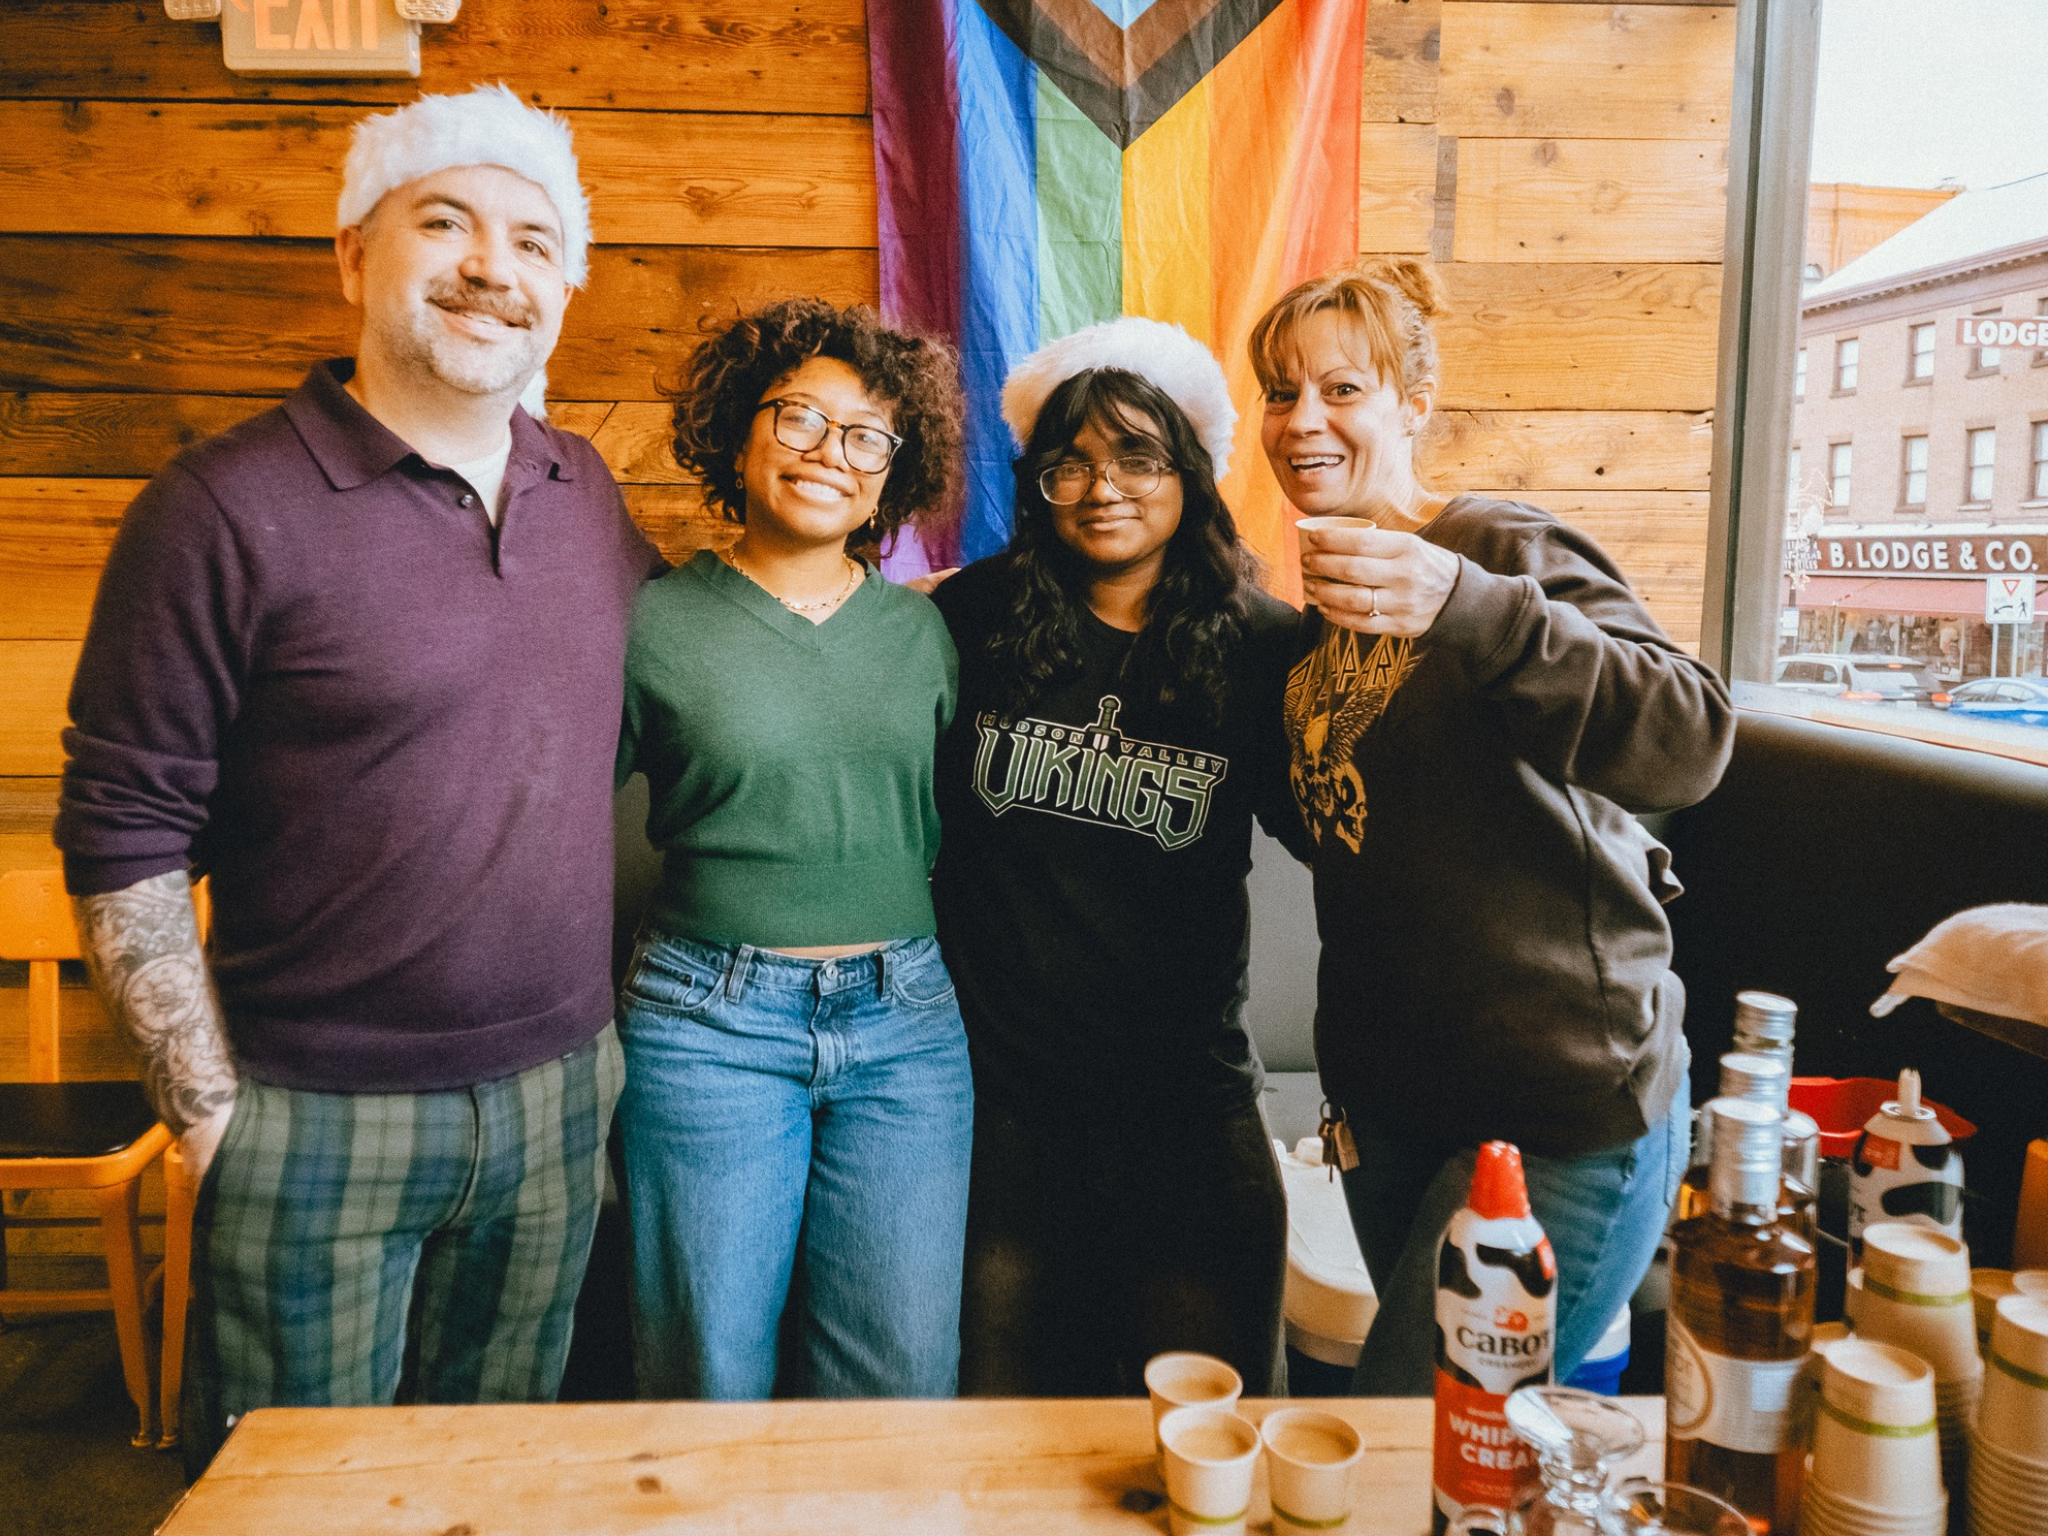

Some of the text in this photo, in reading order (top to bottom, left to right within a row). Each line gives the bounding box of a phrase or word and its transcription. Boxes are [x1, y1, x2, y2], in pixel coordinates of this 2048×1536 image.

[1962, 320, 2048, 347] LODGE
[1959, 541, 1979, 571] &
[1985, 540, 2040, 571] CO.
[1120, 741, 1222, 773] VALLEY
[978, 726, 1217, 848] VIKINGS
[1460, 1441, 1531, 1470] CREA
